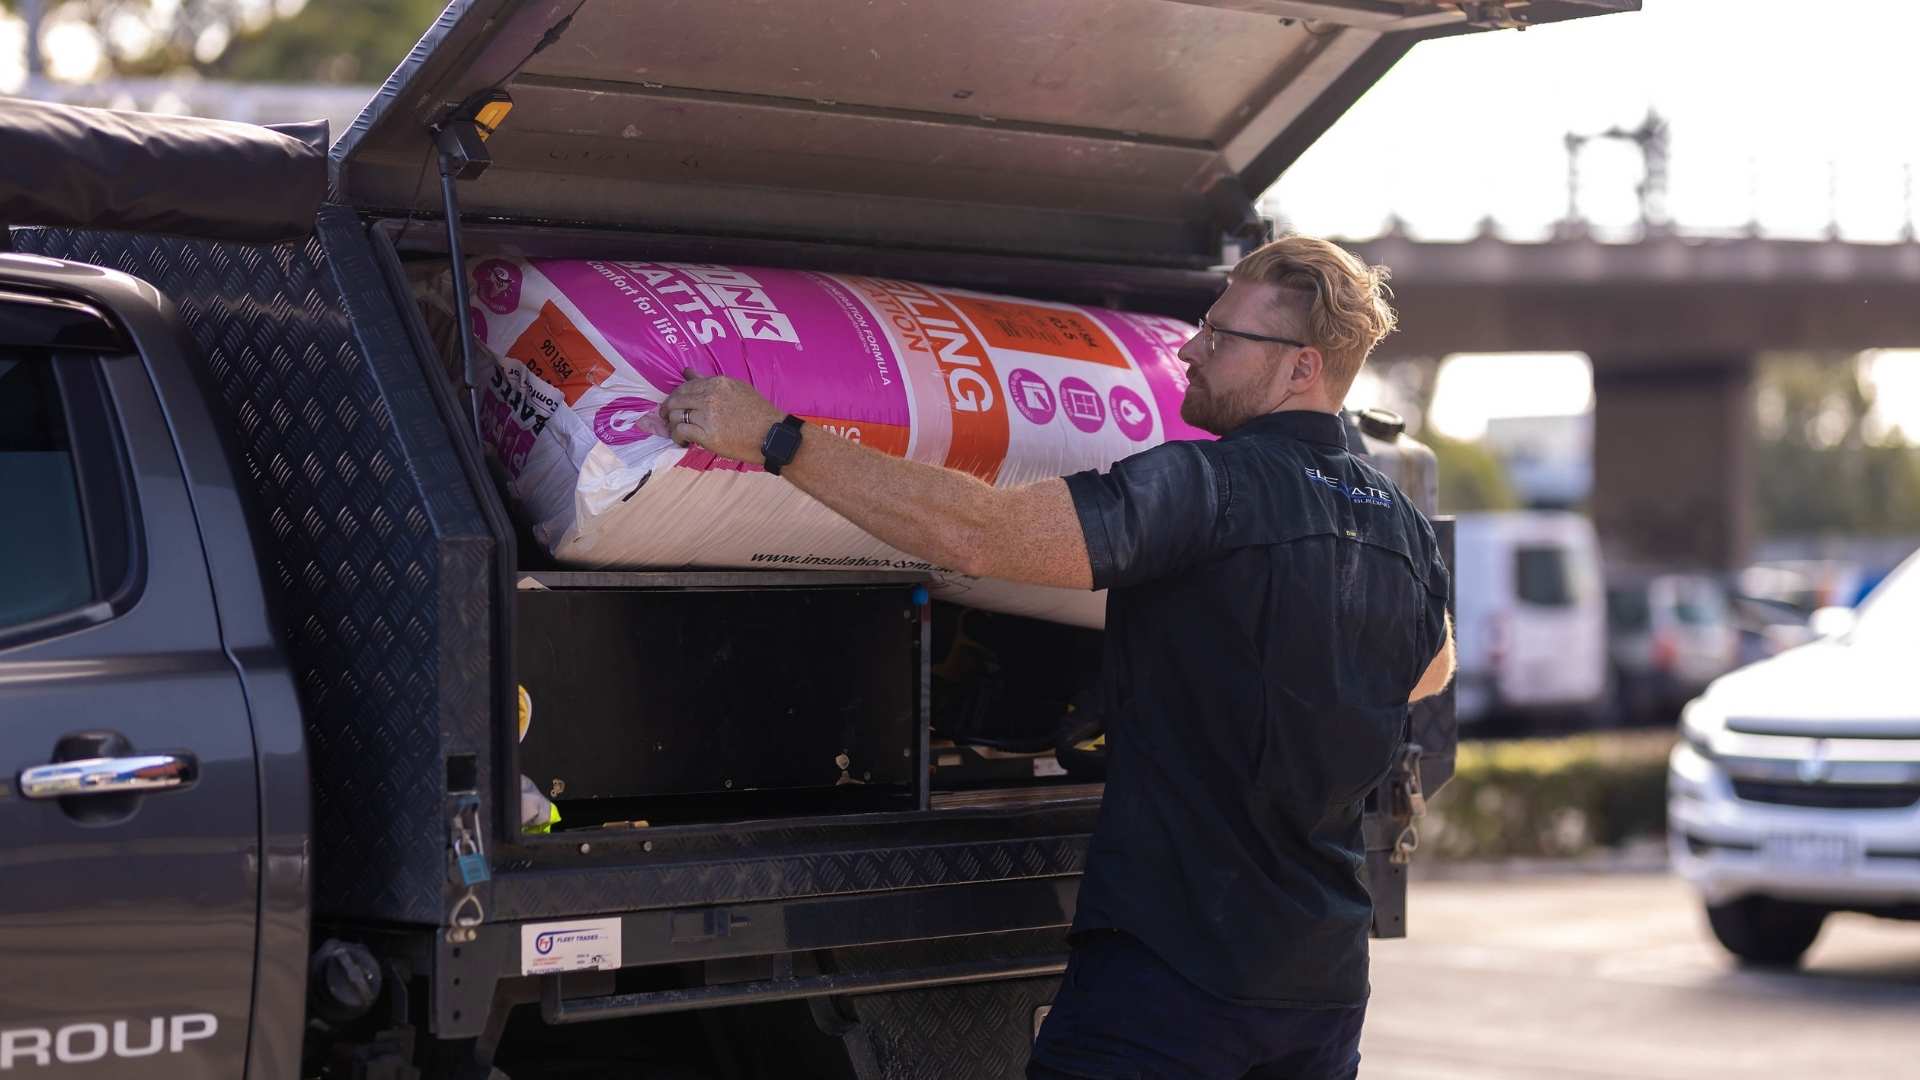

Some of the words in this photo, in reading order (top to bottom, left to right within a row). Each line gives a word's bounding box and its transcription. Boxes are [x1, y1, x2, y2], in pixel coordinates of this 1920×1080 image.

[633, 297, 657, 314] for
[540, 339, 574, 380] 901354
[864, 328, 892, 387] FORMULA
[0, 1013, 218, 1069] ROUP
